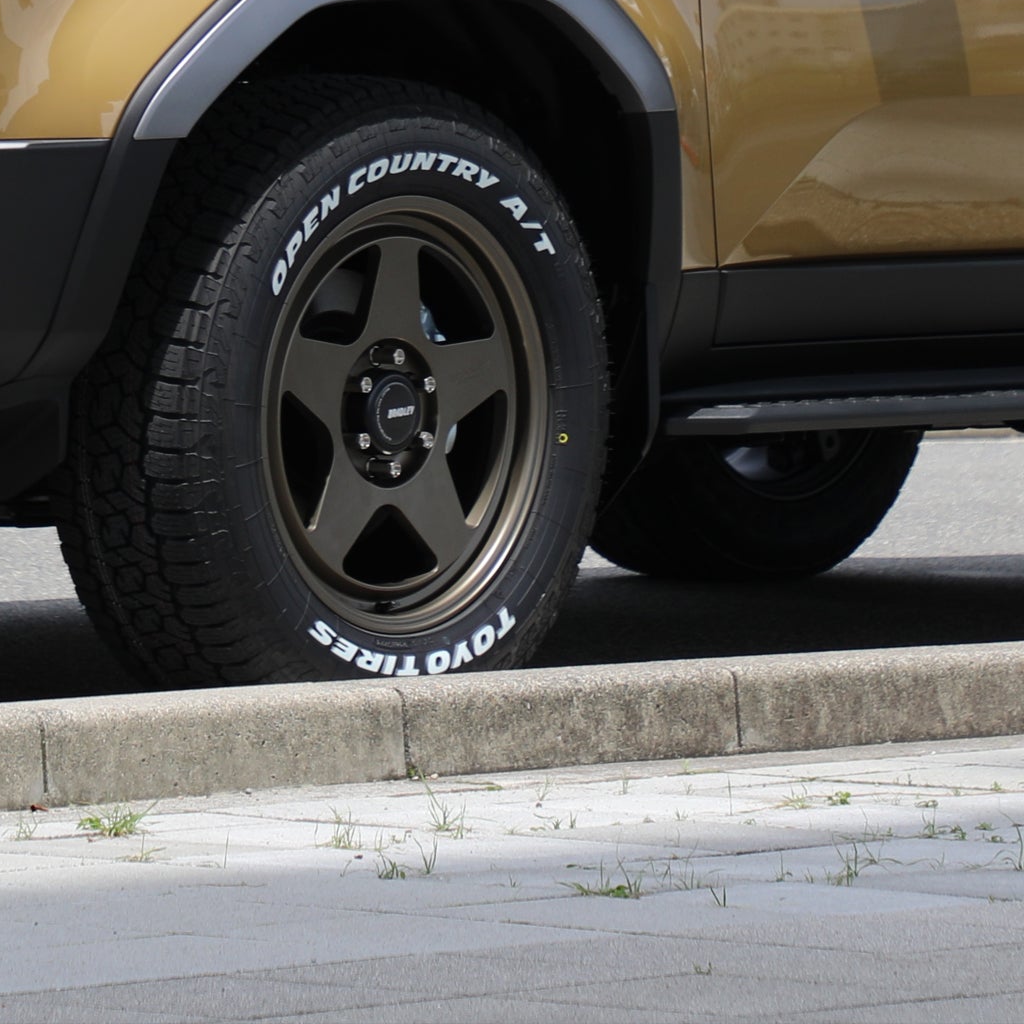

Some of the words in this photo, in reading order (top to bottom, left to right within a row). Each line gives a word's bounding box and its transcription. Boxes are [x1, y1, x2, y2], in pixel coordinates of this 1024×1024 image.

[272, 185, 341, 296] OPEN
[348, 152, 500, 194] COUNTRY
[499, 196, 556, 255] A/T
[307, 619, 420, 677] TIRES
[426, 606, 516, 675] TOYO
